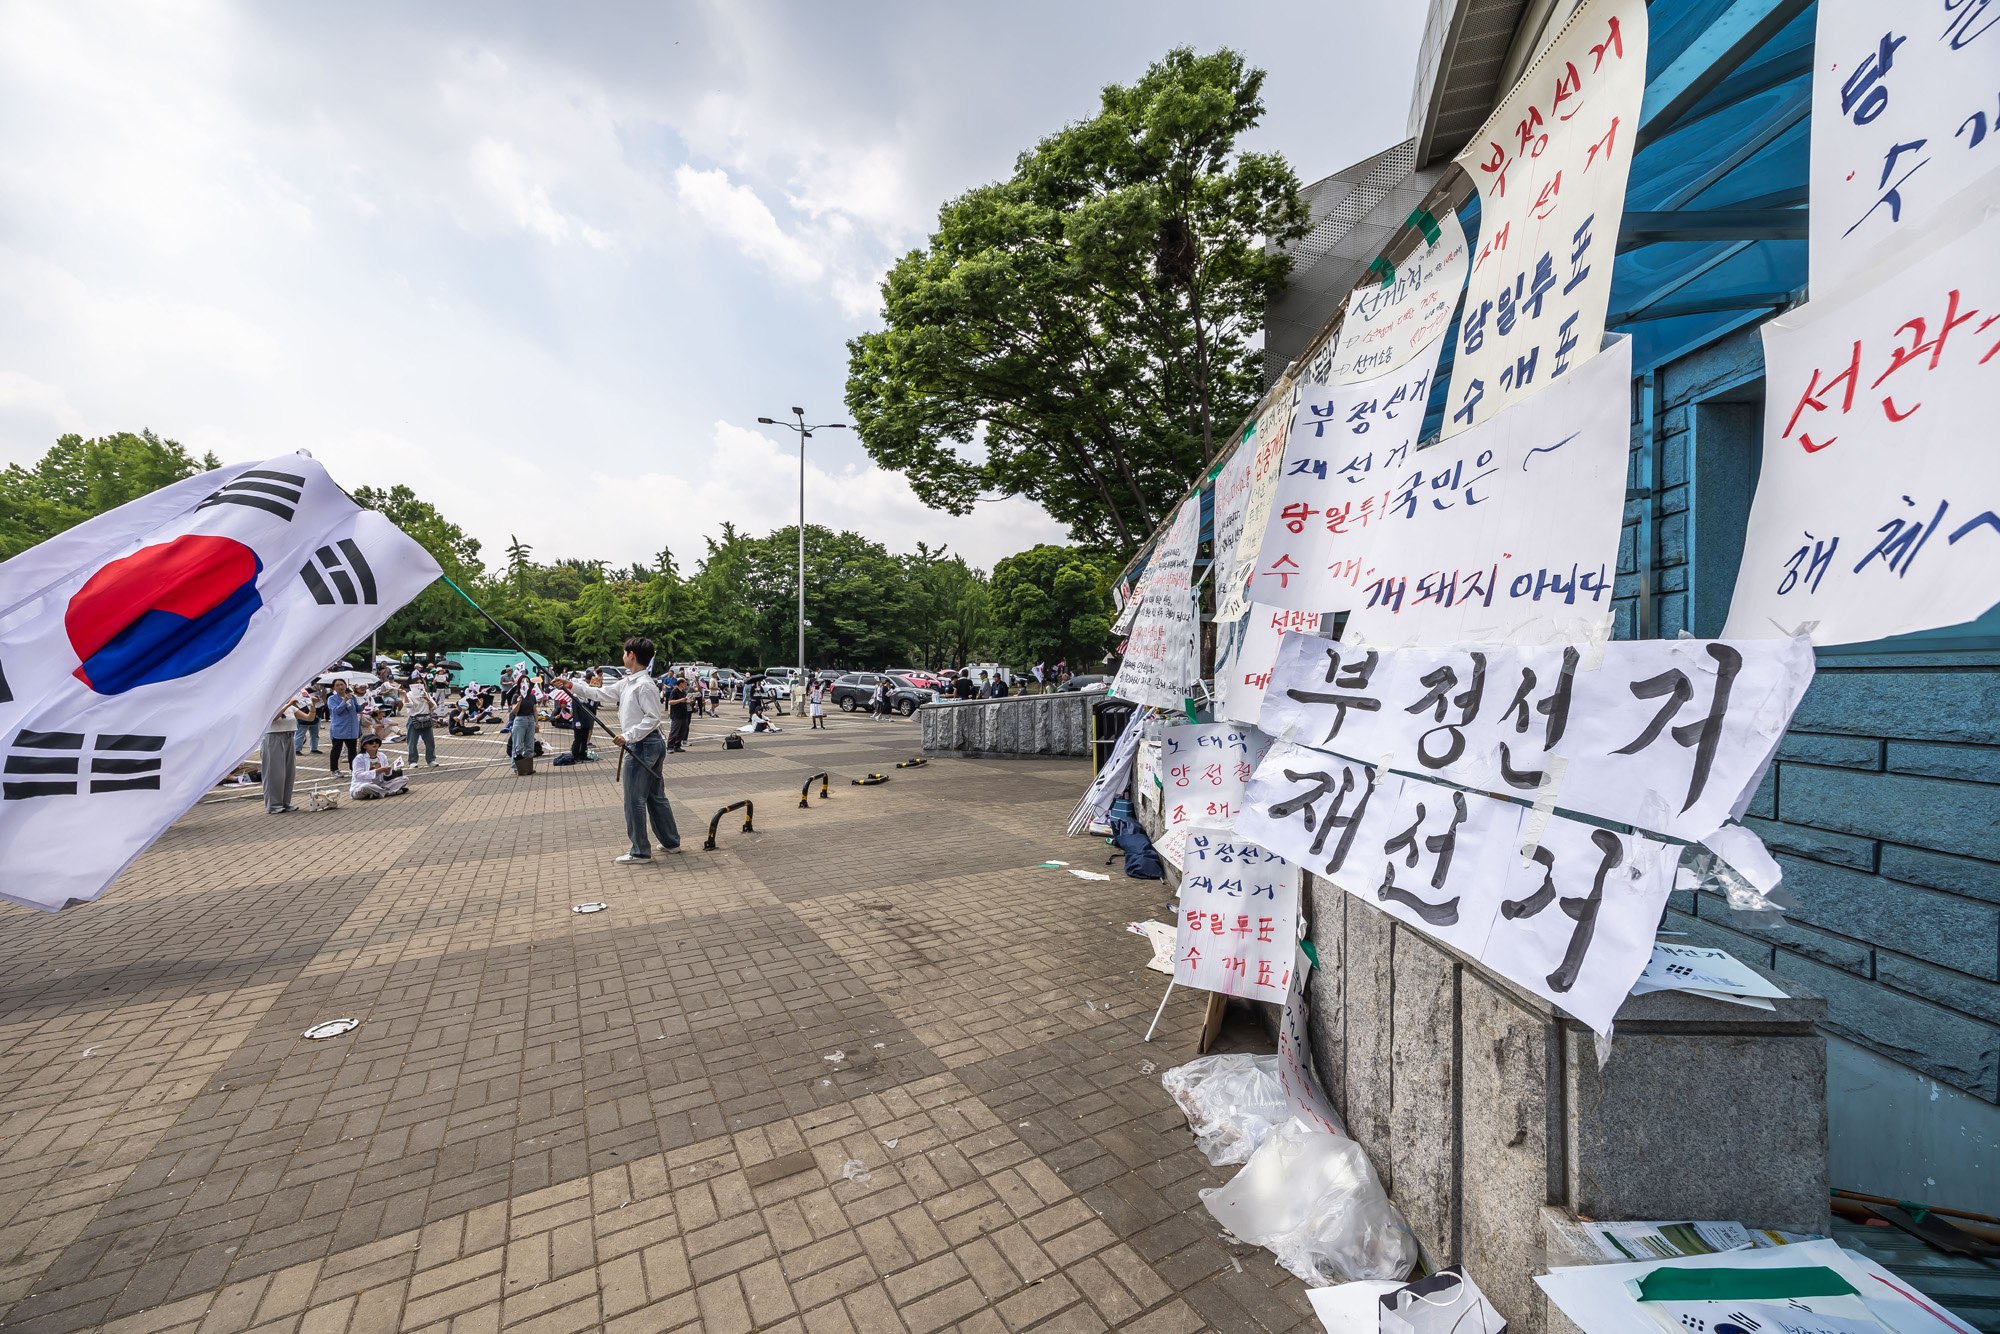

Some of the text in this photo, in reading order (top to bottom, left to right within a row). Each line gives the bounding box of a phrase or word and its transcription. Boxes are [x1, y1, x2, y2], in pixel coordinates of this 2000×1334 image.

[1480, 15, 1623, 198] 부정선거
[1474, 116, 1620, 273] 재선거
[1463, 213, 1596, 355] 당일투표
[1453, 310, 1580, 425] 수개표
[1302, 368, 1430, 437] 부정선거
[1288, 440, 1408, 484] 재선거
[1390, 450, 1500, 519] 국민은
[1281, 490, 1391, 534] 당일투
[1510, 563, 1611, 604] 아니다
[1271, 610, 1319, 635] 선관위
[1287, 643, 1743, 816] 부정선거
[1173, 802, 1242, 825] 조해
[1187, 835, 1286, 865] 부정선거
[1268, 765, 1624, 993] 재선거
